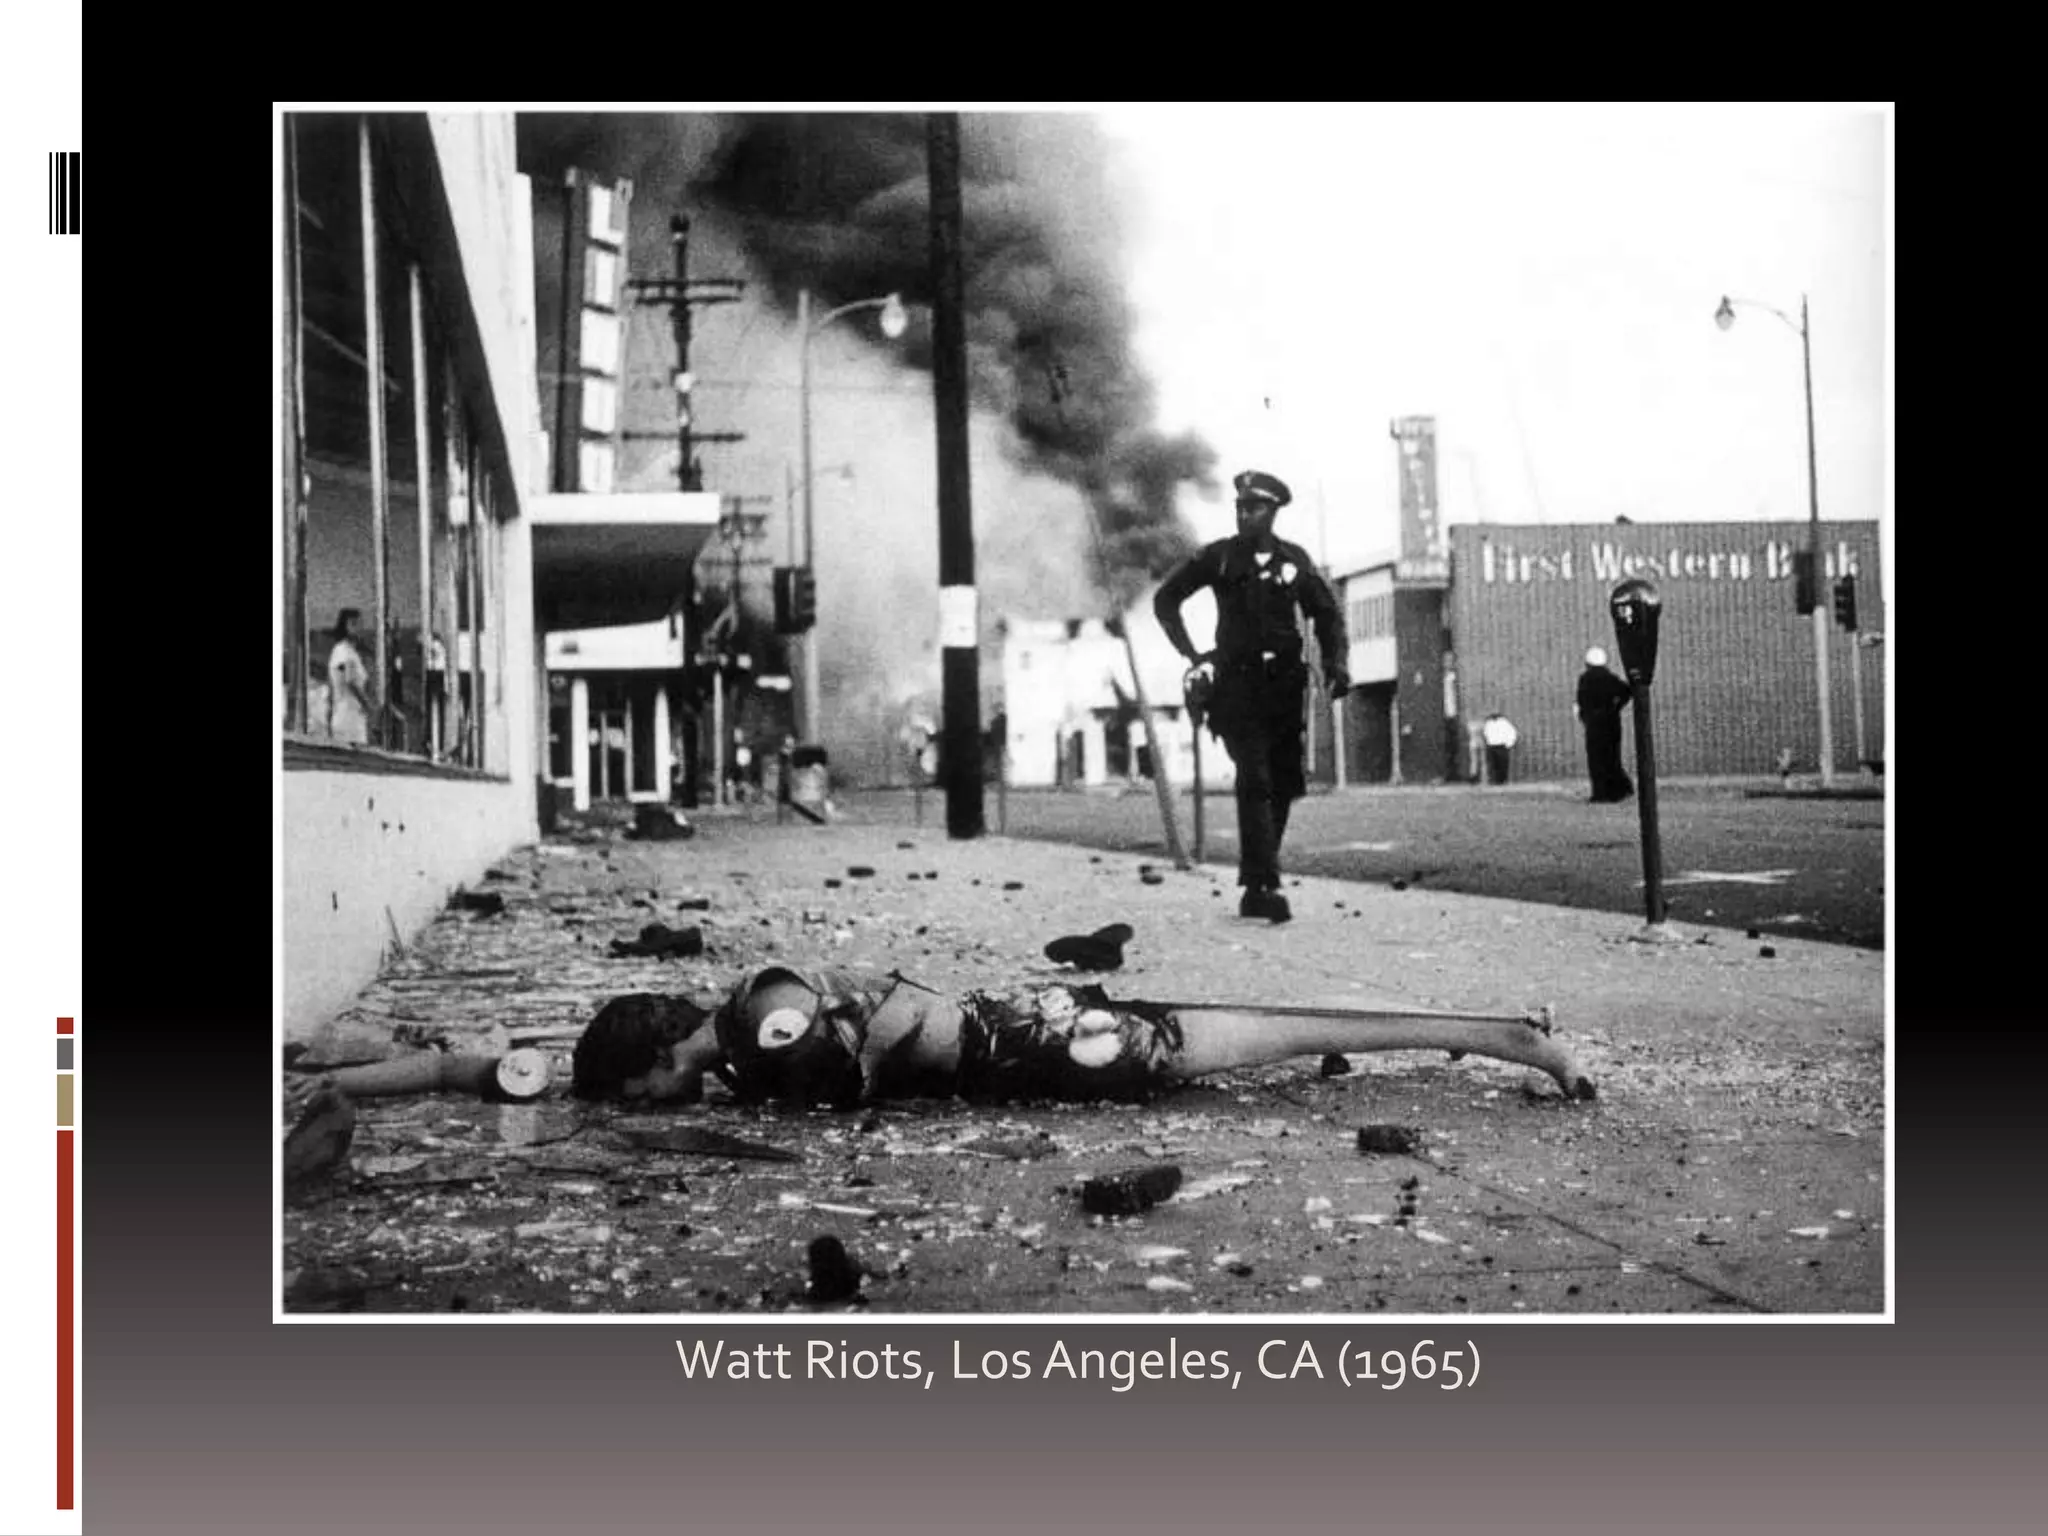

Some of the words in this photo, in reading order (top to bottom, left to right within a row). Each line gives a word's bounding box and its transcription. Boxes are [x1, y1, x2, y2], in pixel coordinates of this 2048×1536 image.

[1481, 540, 1572, 584] First
[1591, 540, 1750, 582] Western
[1767, 539, 1860, 581] Bnk
